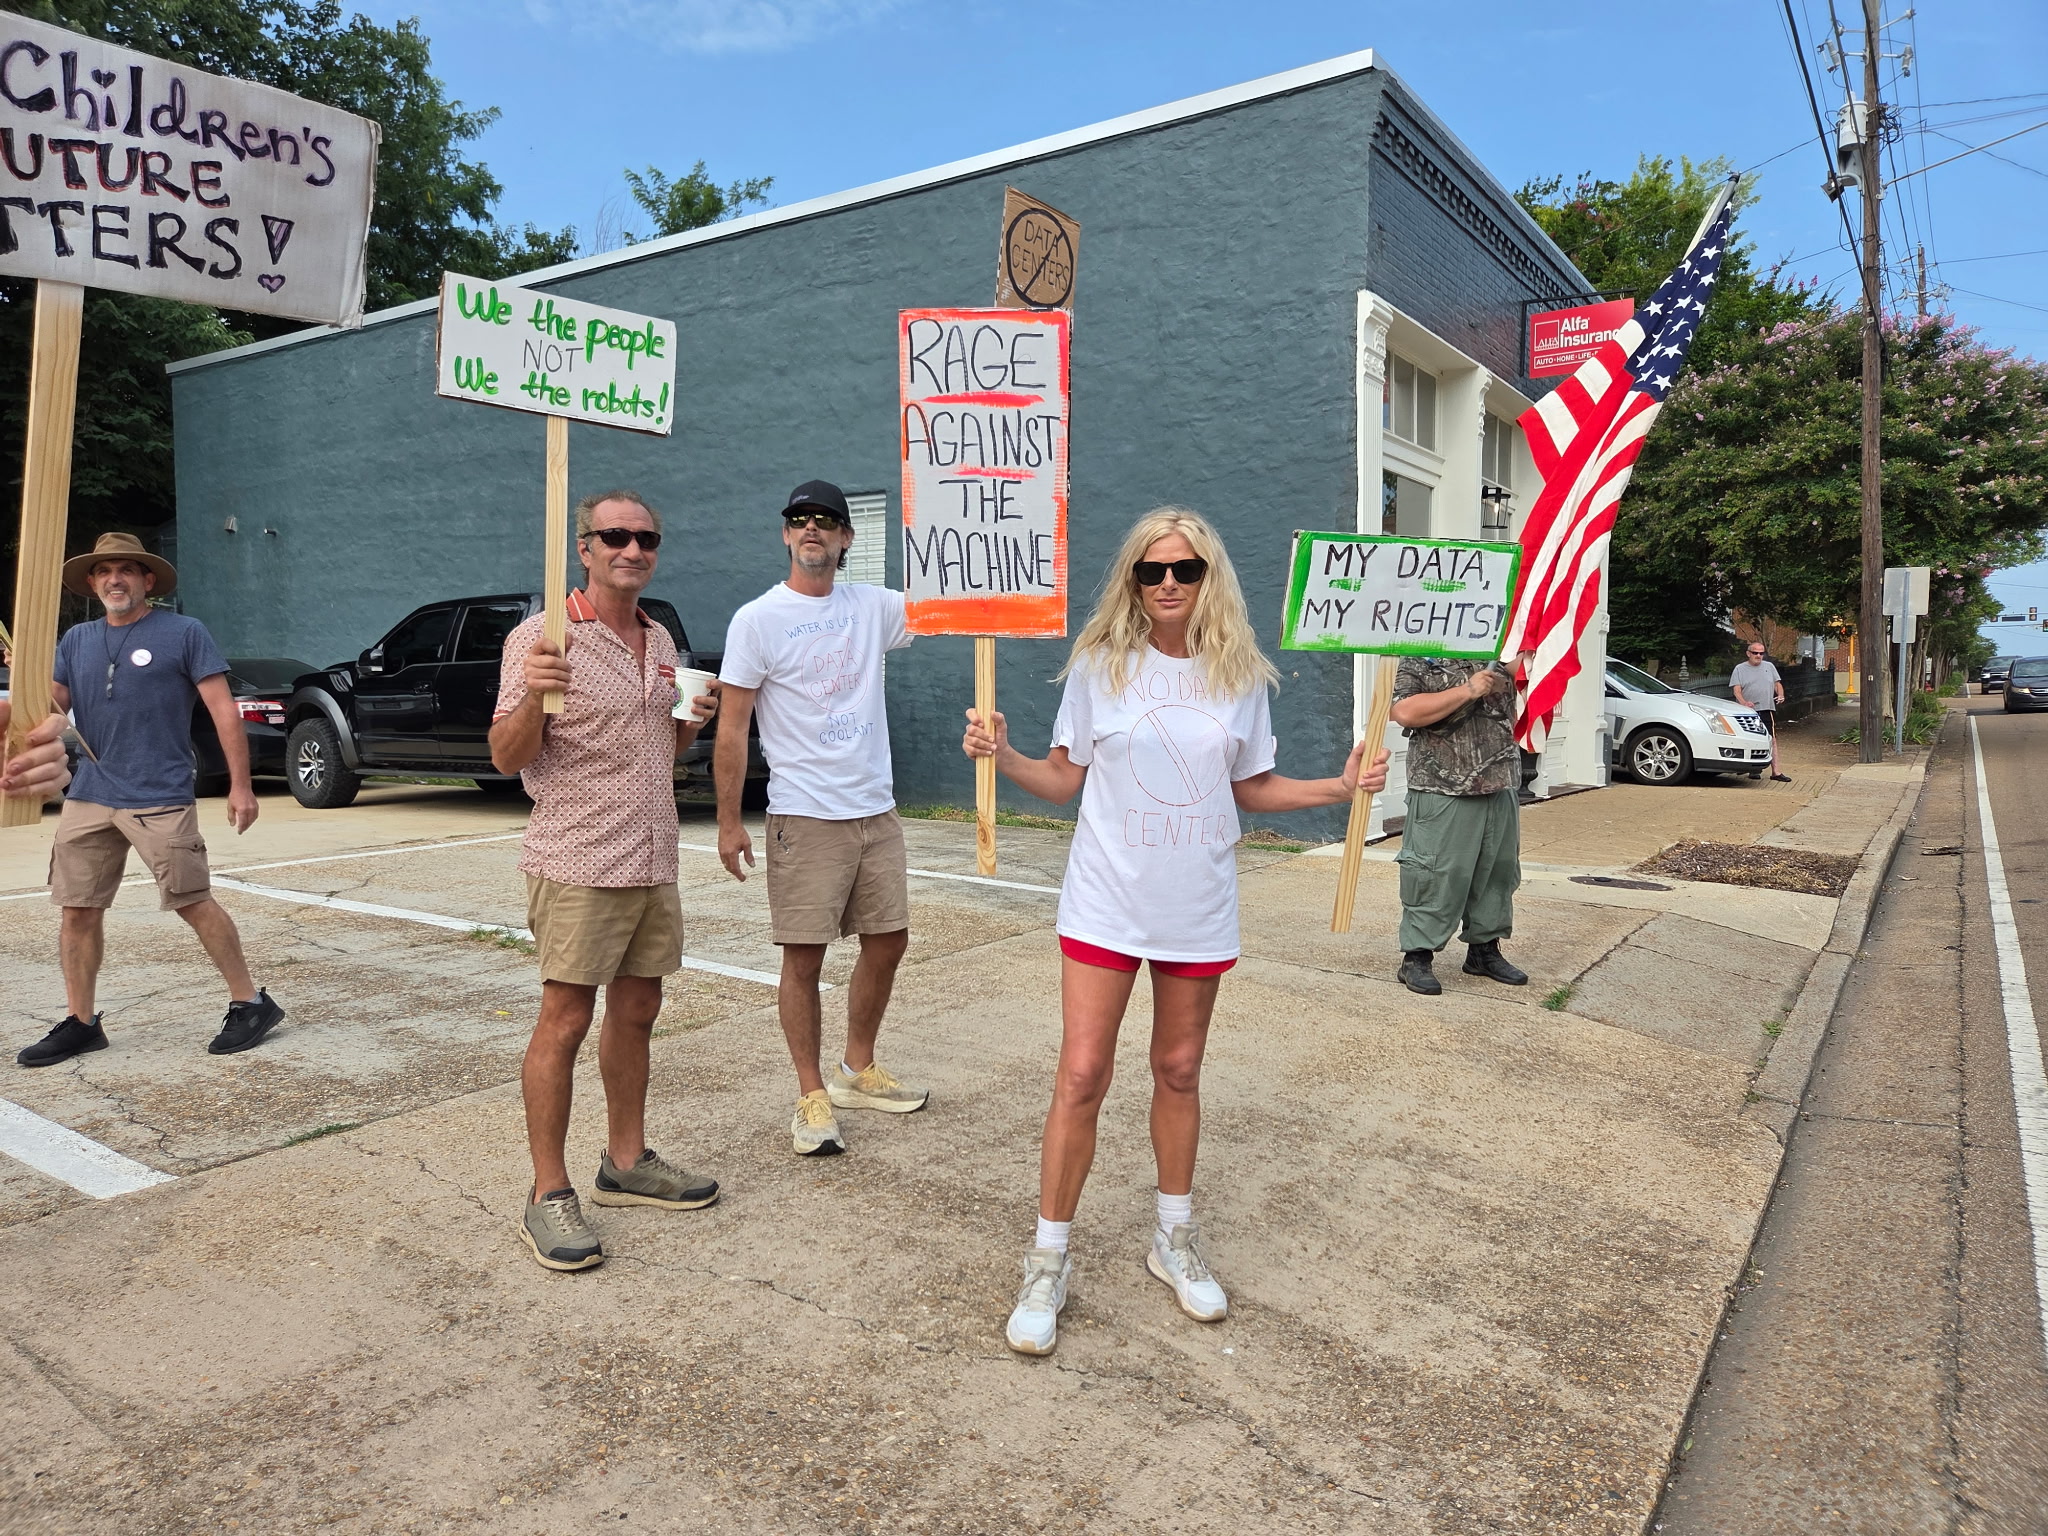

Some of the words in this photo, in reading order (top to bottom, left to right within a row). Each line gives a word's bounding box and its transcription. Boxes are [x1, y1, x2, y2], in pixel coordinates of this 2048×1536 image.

[1024, 219, 1060, 257] DATA
[1011, 244, 1070, 292] CENTERS
[456, 282, 513, 326] We
[527, 298, 578, 341] the
[584, 318, 666, 371] people
[1560, 315, 1590, 333] Alfa
[523, 338, 585, 373] NOT
[907, 317, 1047, 394] RAGE
[1536, 357, 1553, 365] AUTO
[1556, 354, 1574, 362] HOME
[454, 355, 499, 395] We
[519, 370, 572, 407] the
[582, 377, 670, 425] robots!
[905, 403, 1061, 468] AGAINST
[938, 478, 1024, 525] THE
[905, 524, 1055, 596] MACHINE
[1323, 543, 1379, 578] MY
[1397, 545, 1491, 591] DATA,
[785, 622, 822, 639] WATER
[824, 619, 835, 630] IS
[837, 614, 859, 627] LIFE
[1303, 597, 1356, 630] MY
[1370, 598, 1507, 641] RIGHTS!
[814, 650, 857, 673] DATA
[810, 673, 861, 697] CENTER
[1121, 670, 1171, 705] NO
[1178, 671, 1235, 705] DAA
[819, 723, 874, 744] COOLANT
[828, 711, 858, 728] NOT
[1123, 808, 1228, 848] CENTER
